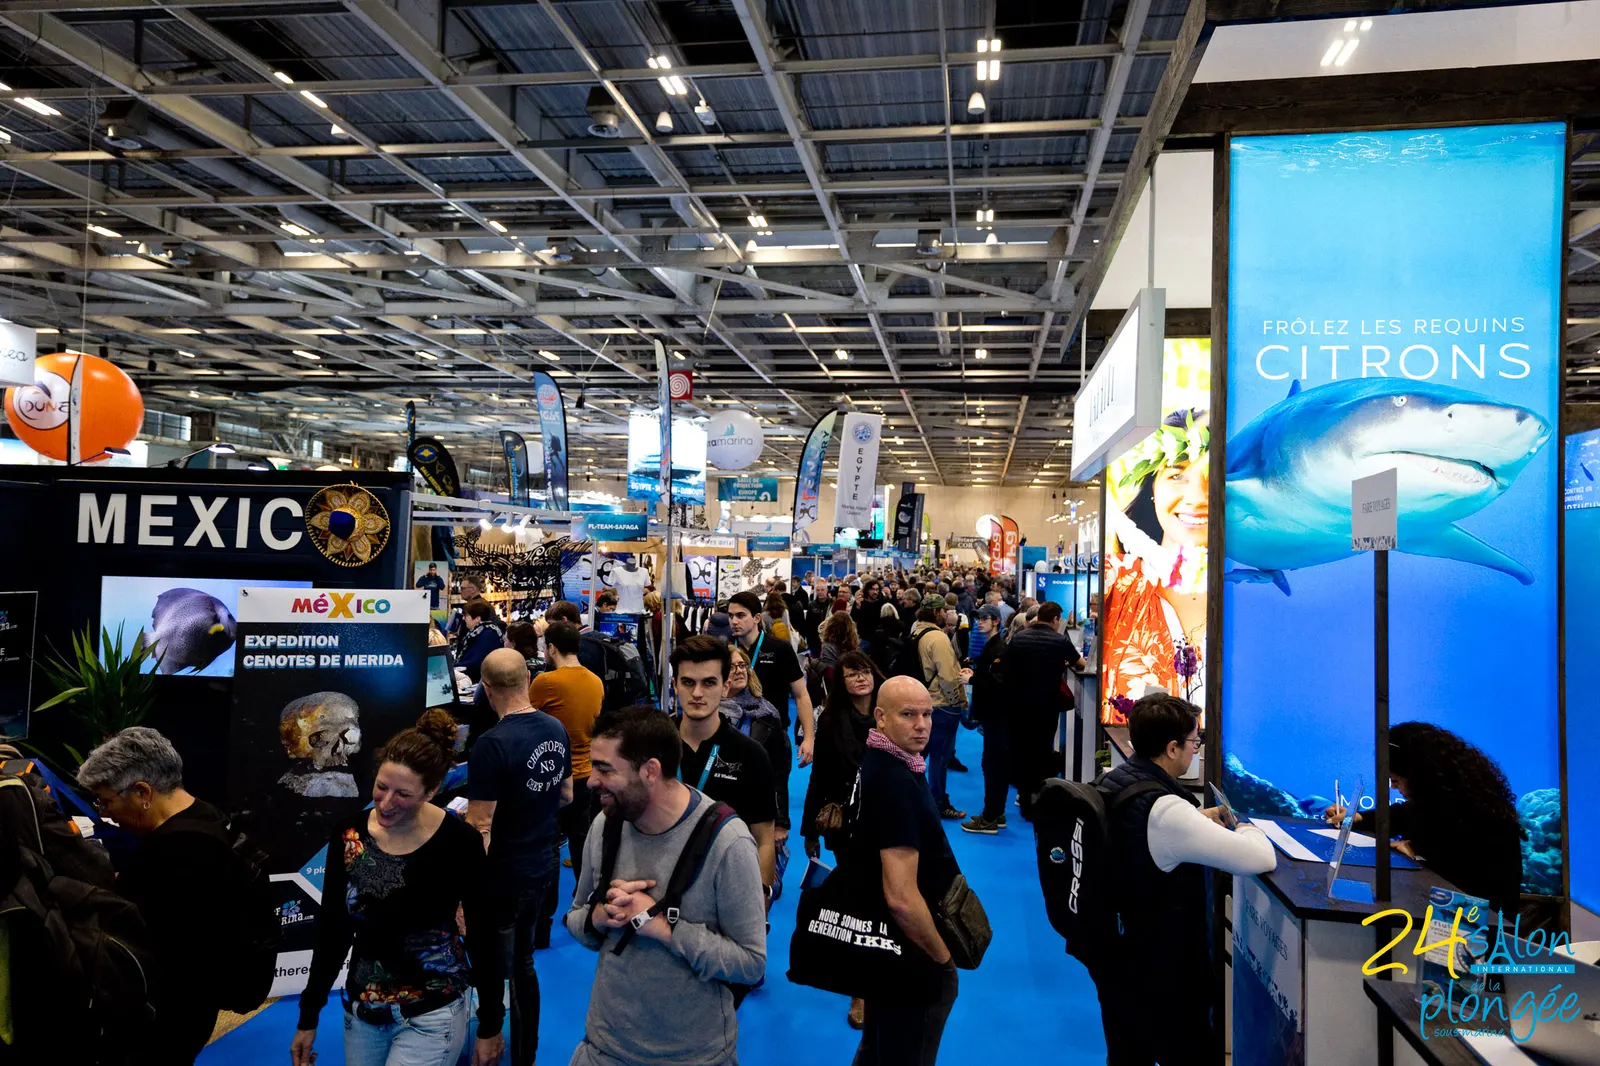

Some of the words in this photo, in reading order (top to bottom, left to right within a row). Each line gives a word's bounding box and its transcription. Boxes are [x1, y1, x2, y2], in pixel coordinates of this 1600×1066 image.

[1262, 317, 1349, 336] FRÔLEZ
[1361, 319, 1402, 335] LES
[1414, 316, 1526, 335] REQUINS
[1255, 342, 1532, 381] CITRONS
[852, 447, 864, 501] EGYPTE
[588, 523, 639, 531] FL-TEAM-SAFAGA
[244, 634, 340, 649] EXPEDITION
[243, 654, 316, 669] CENOTES
[319, 654, 341, 668] DE
[344, 653, 404, 668] MERIDA
[540, 759, 556, 774] N3
[526, 778, 544, 792] CHEF
[1068, 817, 1085, 915] CRESSI
[808, 919, 852, 943] GENERATION
[818, 908, 840, 923] NOUS
[840, 913, 873, 933] SOMMES
[879, 922, 888, 936] LA
